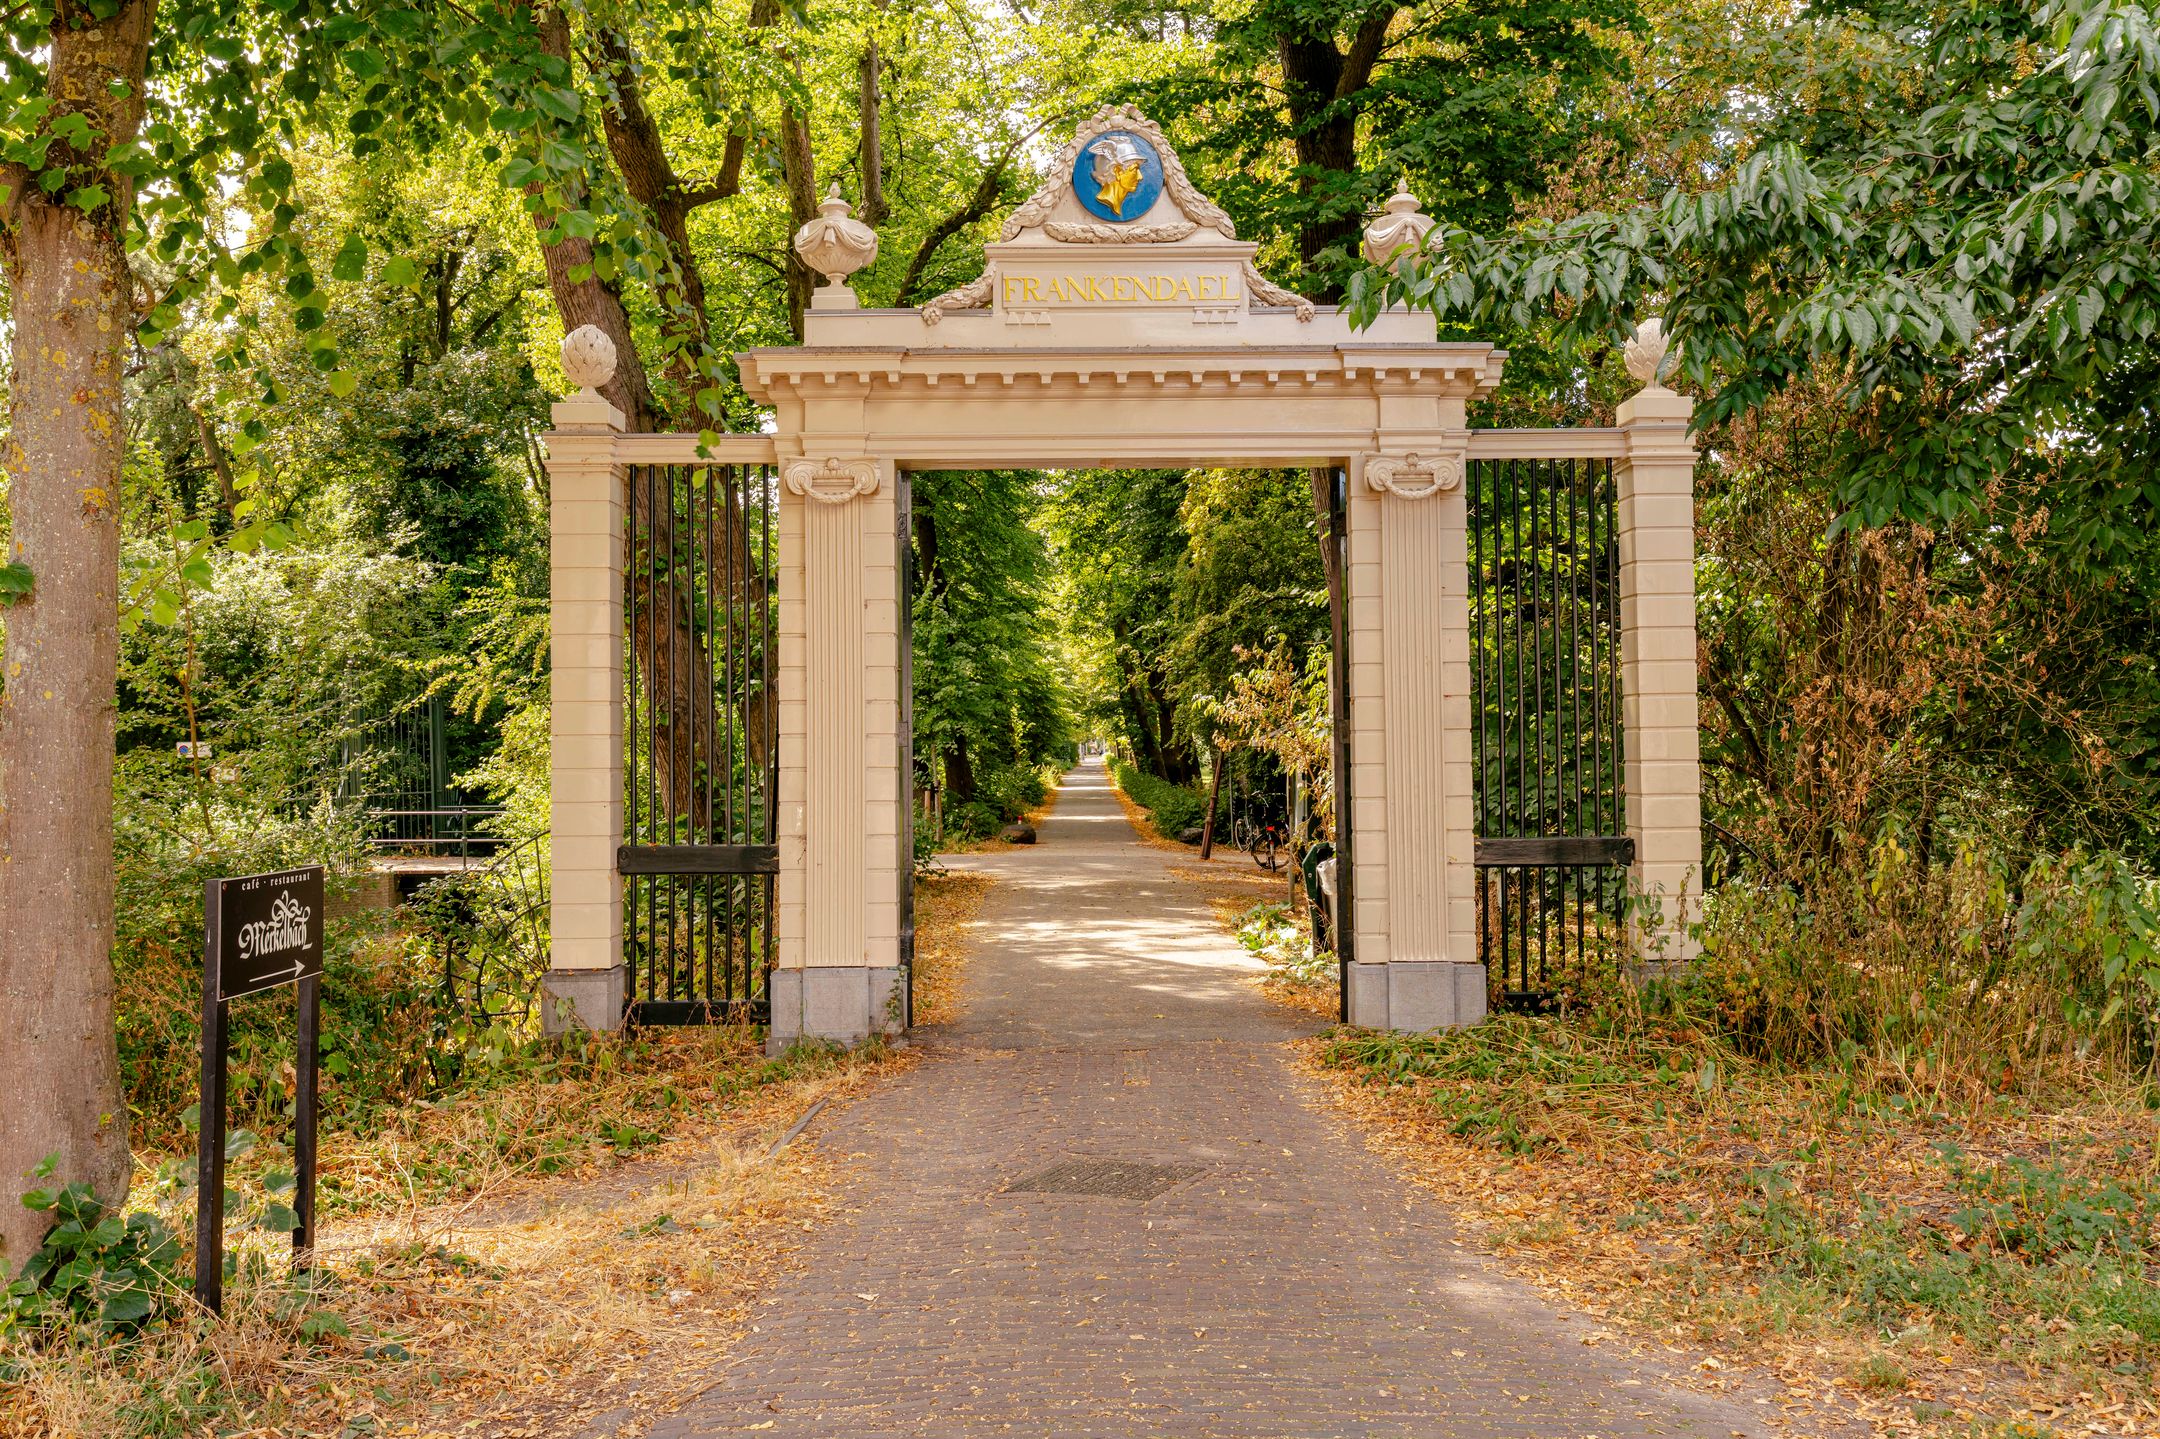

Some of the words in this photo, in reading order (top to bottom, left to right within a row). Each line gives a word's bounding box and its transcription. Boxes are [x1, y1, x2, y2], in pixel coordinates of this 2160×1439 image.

[1003, 275, 1240, 302] FRANKENDAEL
[241, 879, 260, 891] café
[270, 872, 310, 886] restaurant
[238, 889, 313, 960] Merkelbach
